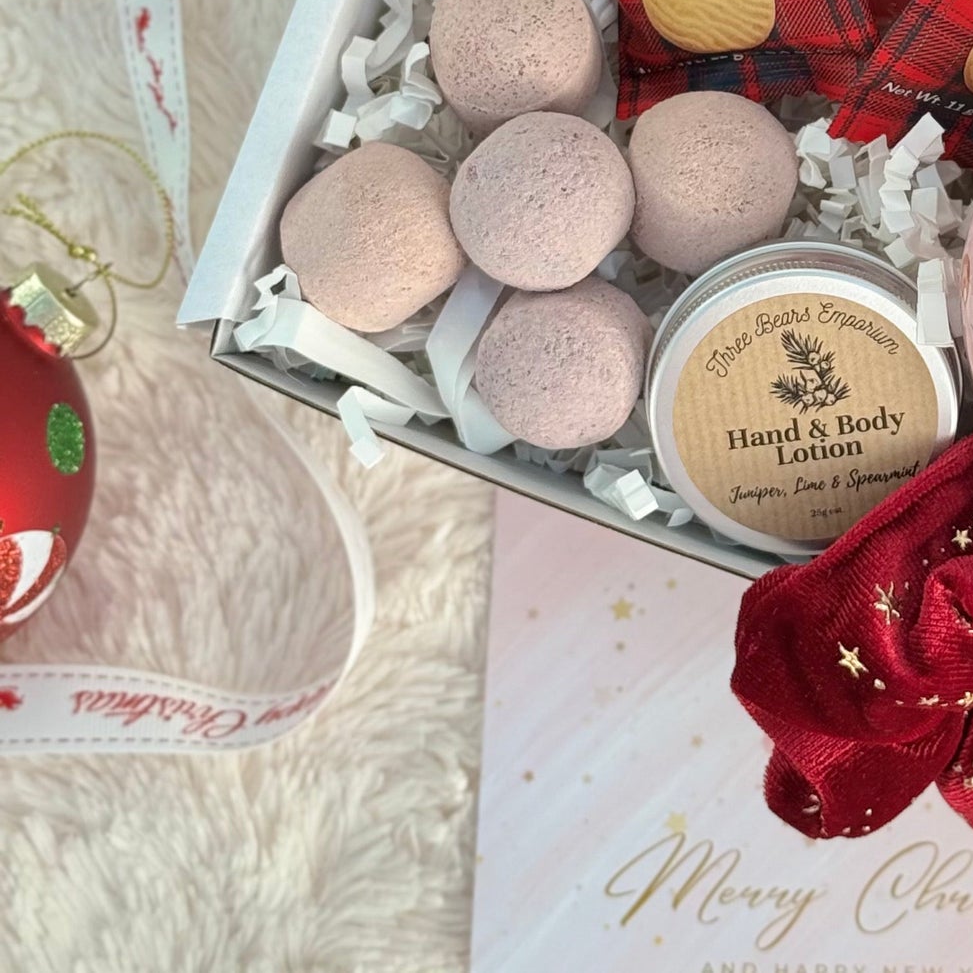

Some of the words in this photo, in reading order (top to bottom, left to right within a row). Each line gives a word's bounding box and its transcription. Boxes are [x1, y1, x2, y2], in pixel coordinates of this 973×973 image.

[881, 81, 915, 98] Net
[915, 91, 942, 107] Wt.
[705, 332, 752, 378] Three
[755, 306, 811, 337] Bears
[817, 302, 902, 356] Emporium
[726, 417, 801, 451] Hand
[808, 418, 831, 442] &
[835, 405, 906, 436] Body
[776, 438, 864, 466] Lotion
[729, 484, 788, 505] Juniper,
[793, 469, 828, 495] Lime
[831, 475, 841, 489] &
[846, 459, 921, 492] Spearmint
[71, 688, 248, 740] Christmas
[603, 831, 826, 952] Merry
